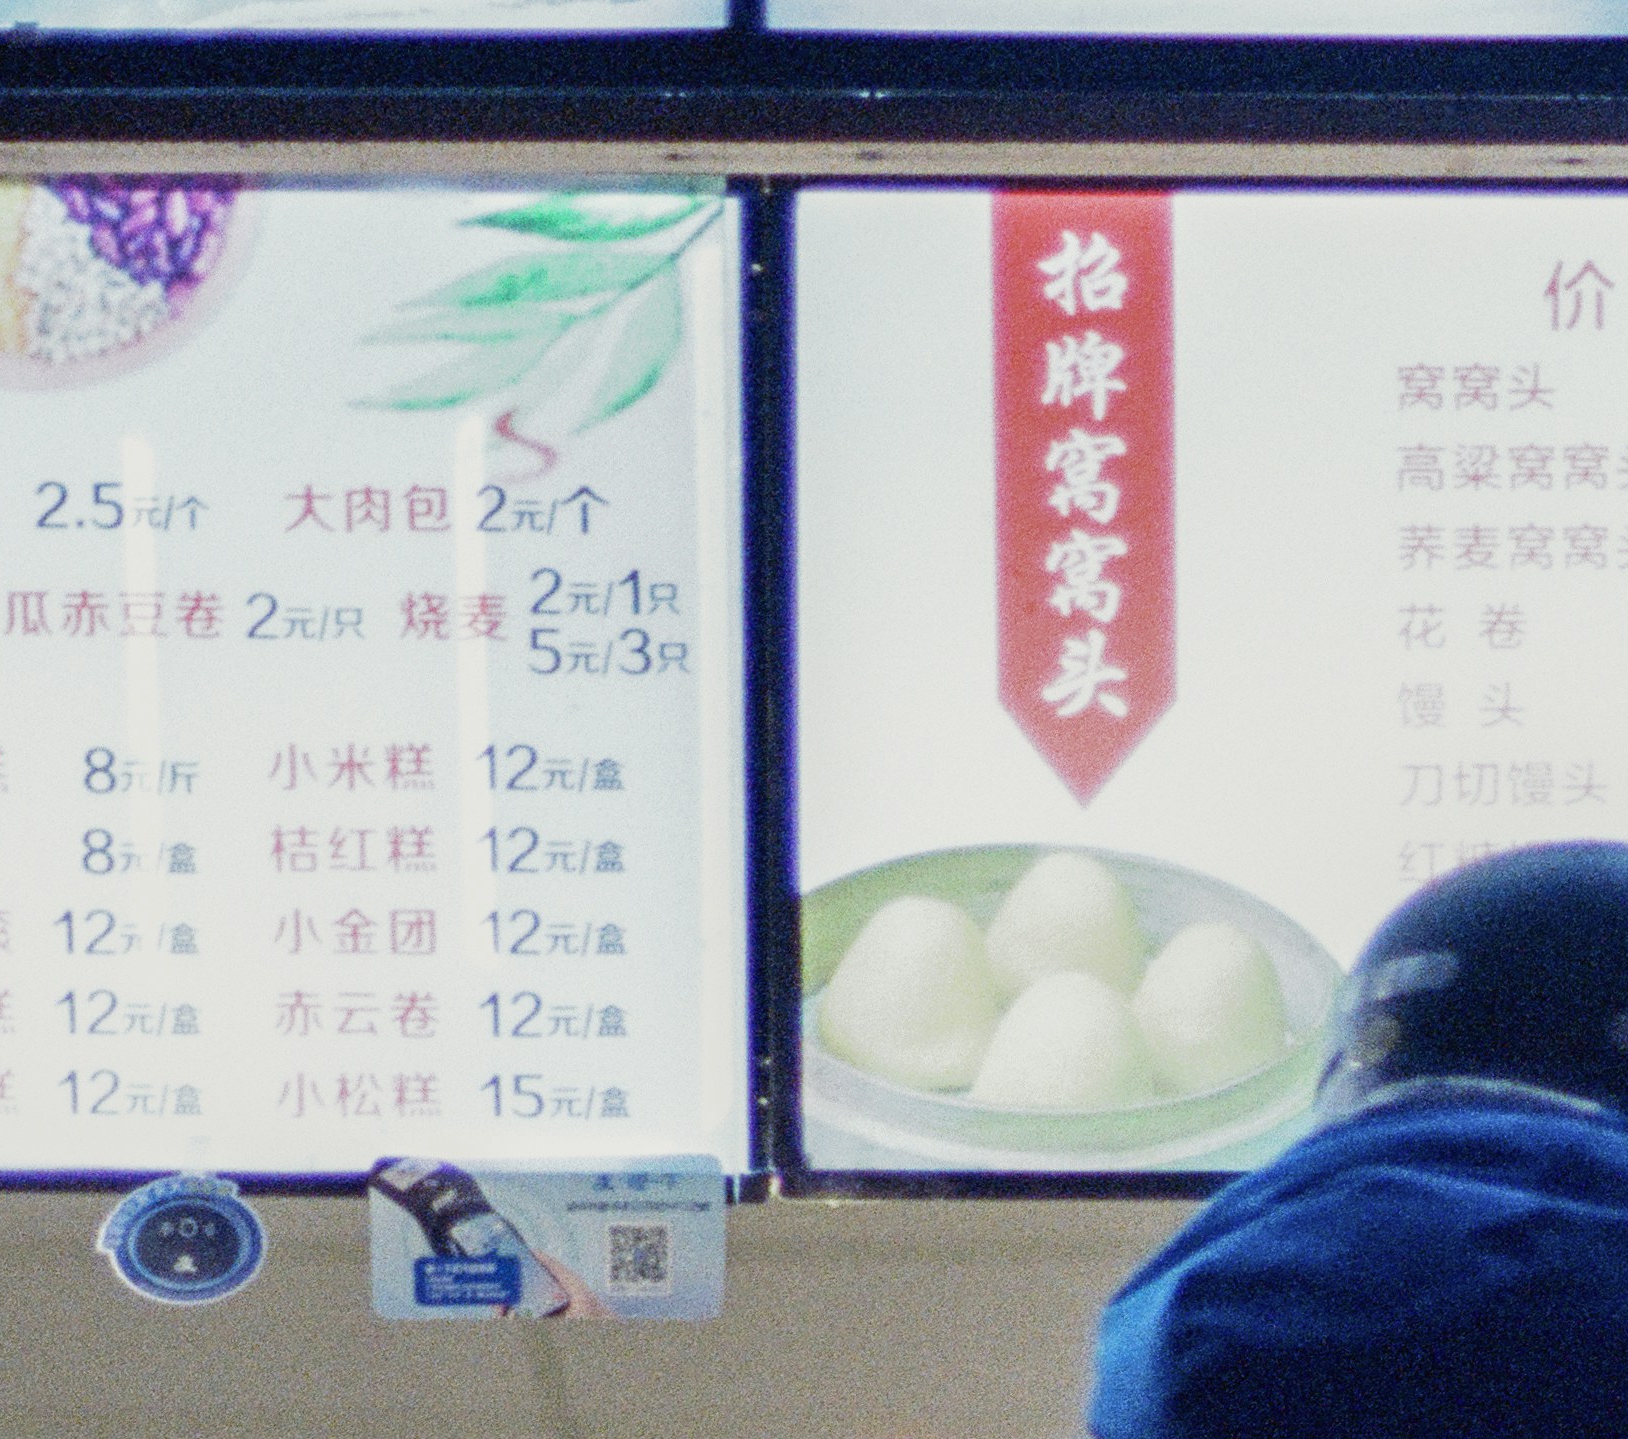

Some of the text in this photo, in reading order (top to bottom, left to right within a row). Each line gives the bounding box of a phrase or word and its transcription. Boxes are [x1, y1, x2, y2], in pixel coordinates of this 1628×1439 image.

[1397, 362, 1553, 411] 窝窝头
[1036, 229, 1129, 723] 招牌窝窝头
[35, 480, 204, 531] 2.5元/个
[287, 480, 608, 535] 大肉包 2元/个
[245, 591, 363, 640] 2元/只
[401, 567, 678, 642] 烧麦 2元/1只
[529, 627, 689, 676] 5元/3只
[270, 743, 623, 792] 小米糕 12元/盒
[1400, 760, 1608, 807] 刀切馒头
[271, 826, 625, 874] 桔红糕 12元/盒
[275, 907, 626, 956] 小金团 12元/盒
[57, 989, 199, 1035] 12元/盒
[277, 989, 627, 1038] 赤云卷 12元/盒
[59, 1069, 201, 1115] 12元/盒
[279, 1073, 629, 1118] 小松糕 15元/盒
